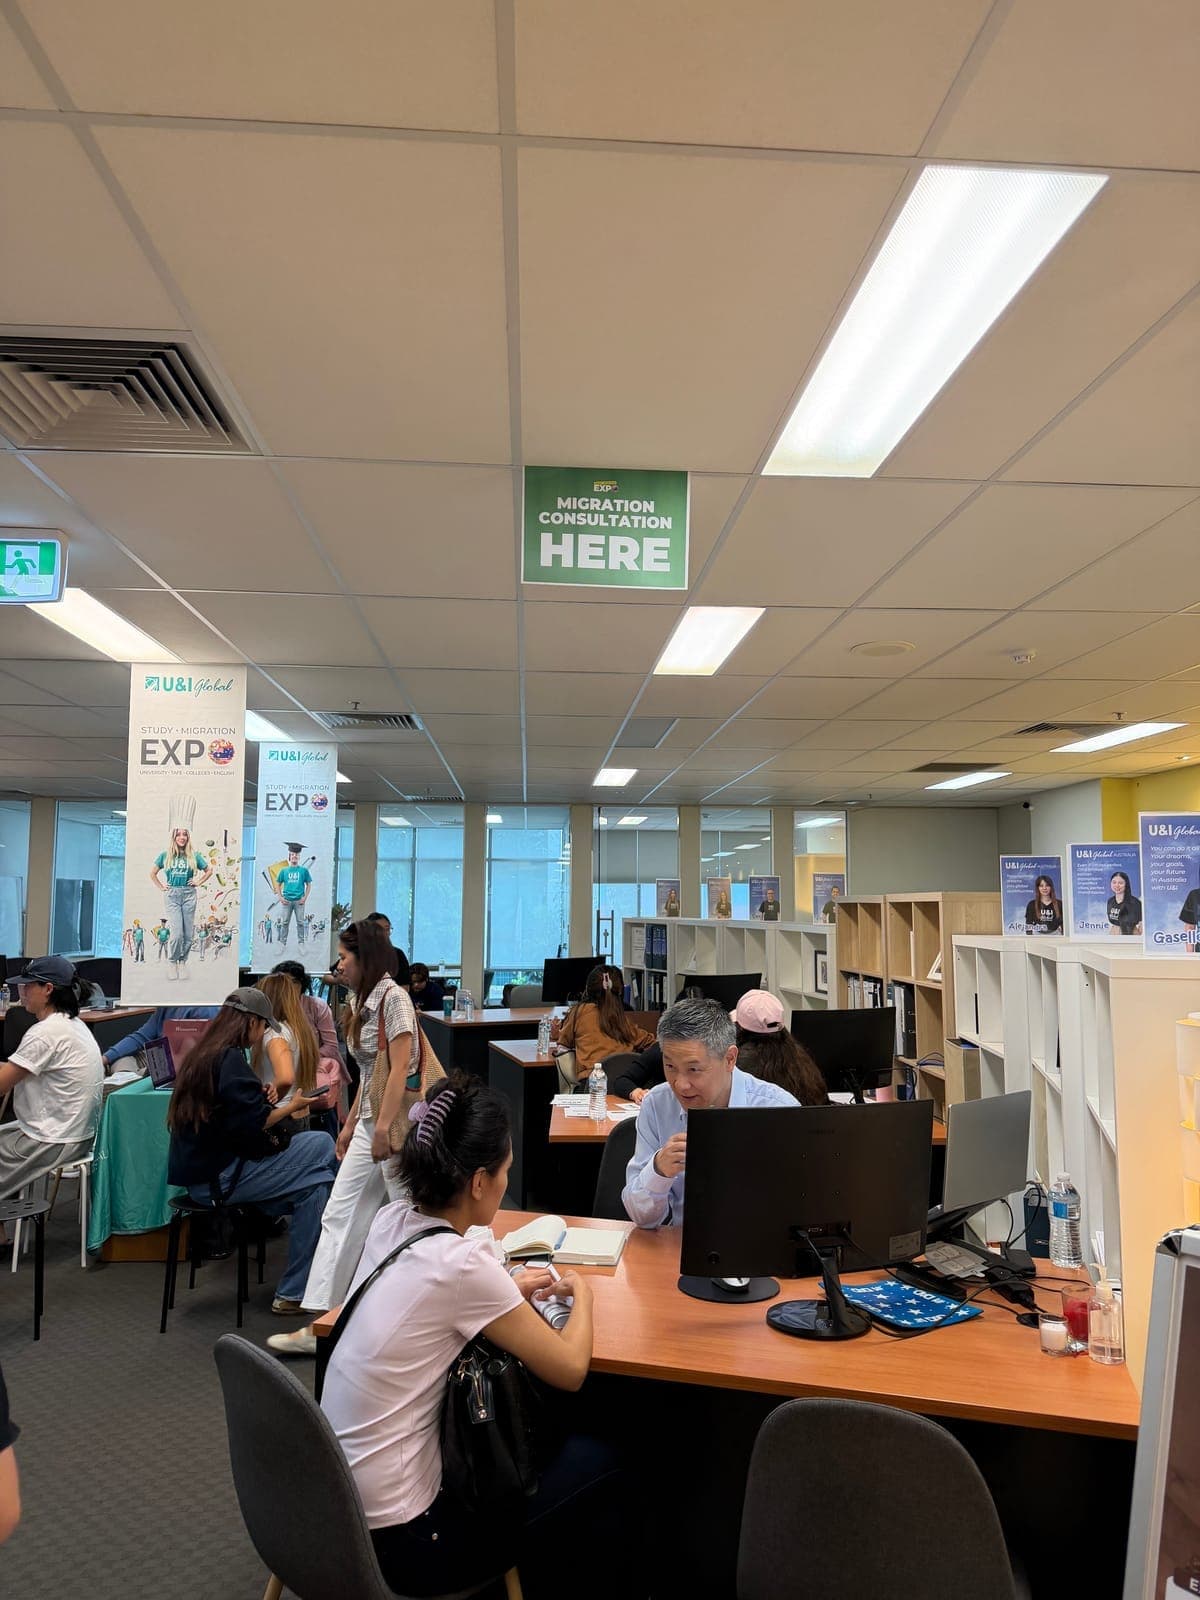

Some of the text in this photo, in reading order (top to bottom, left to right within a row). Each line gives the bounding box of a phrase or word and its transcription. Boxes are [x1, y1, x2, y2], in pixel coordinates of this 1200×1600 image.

[557, 496, 654, 512] MIGRATION
[538, 512, 672, 529] CONSULTATION
[540, 532, 670, 572] HERE
[163, 677, 234, 697] U&I Global
[281, 750, 300, 761] U&I
[1148, 824, 1172, 836] U&I
